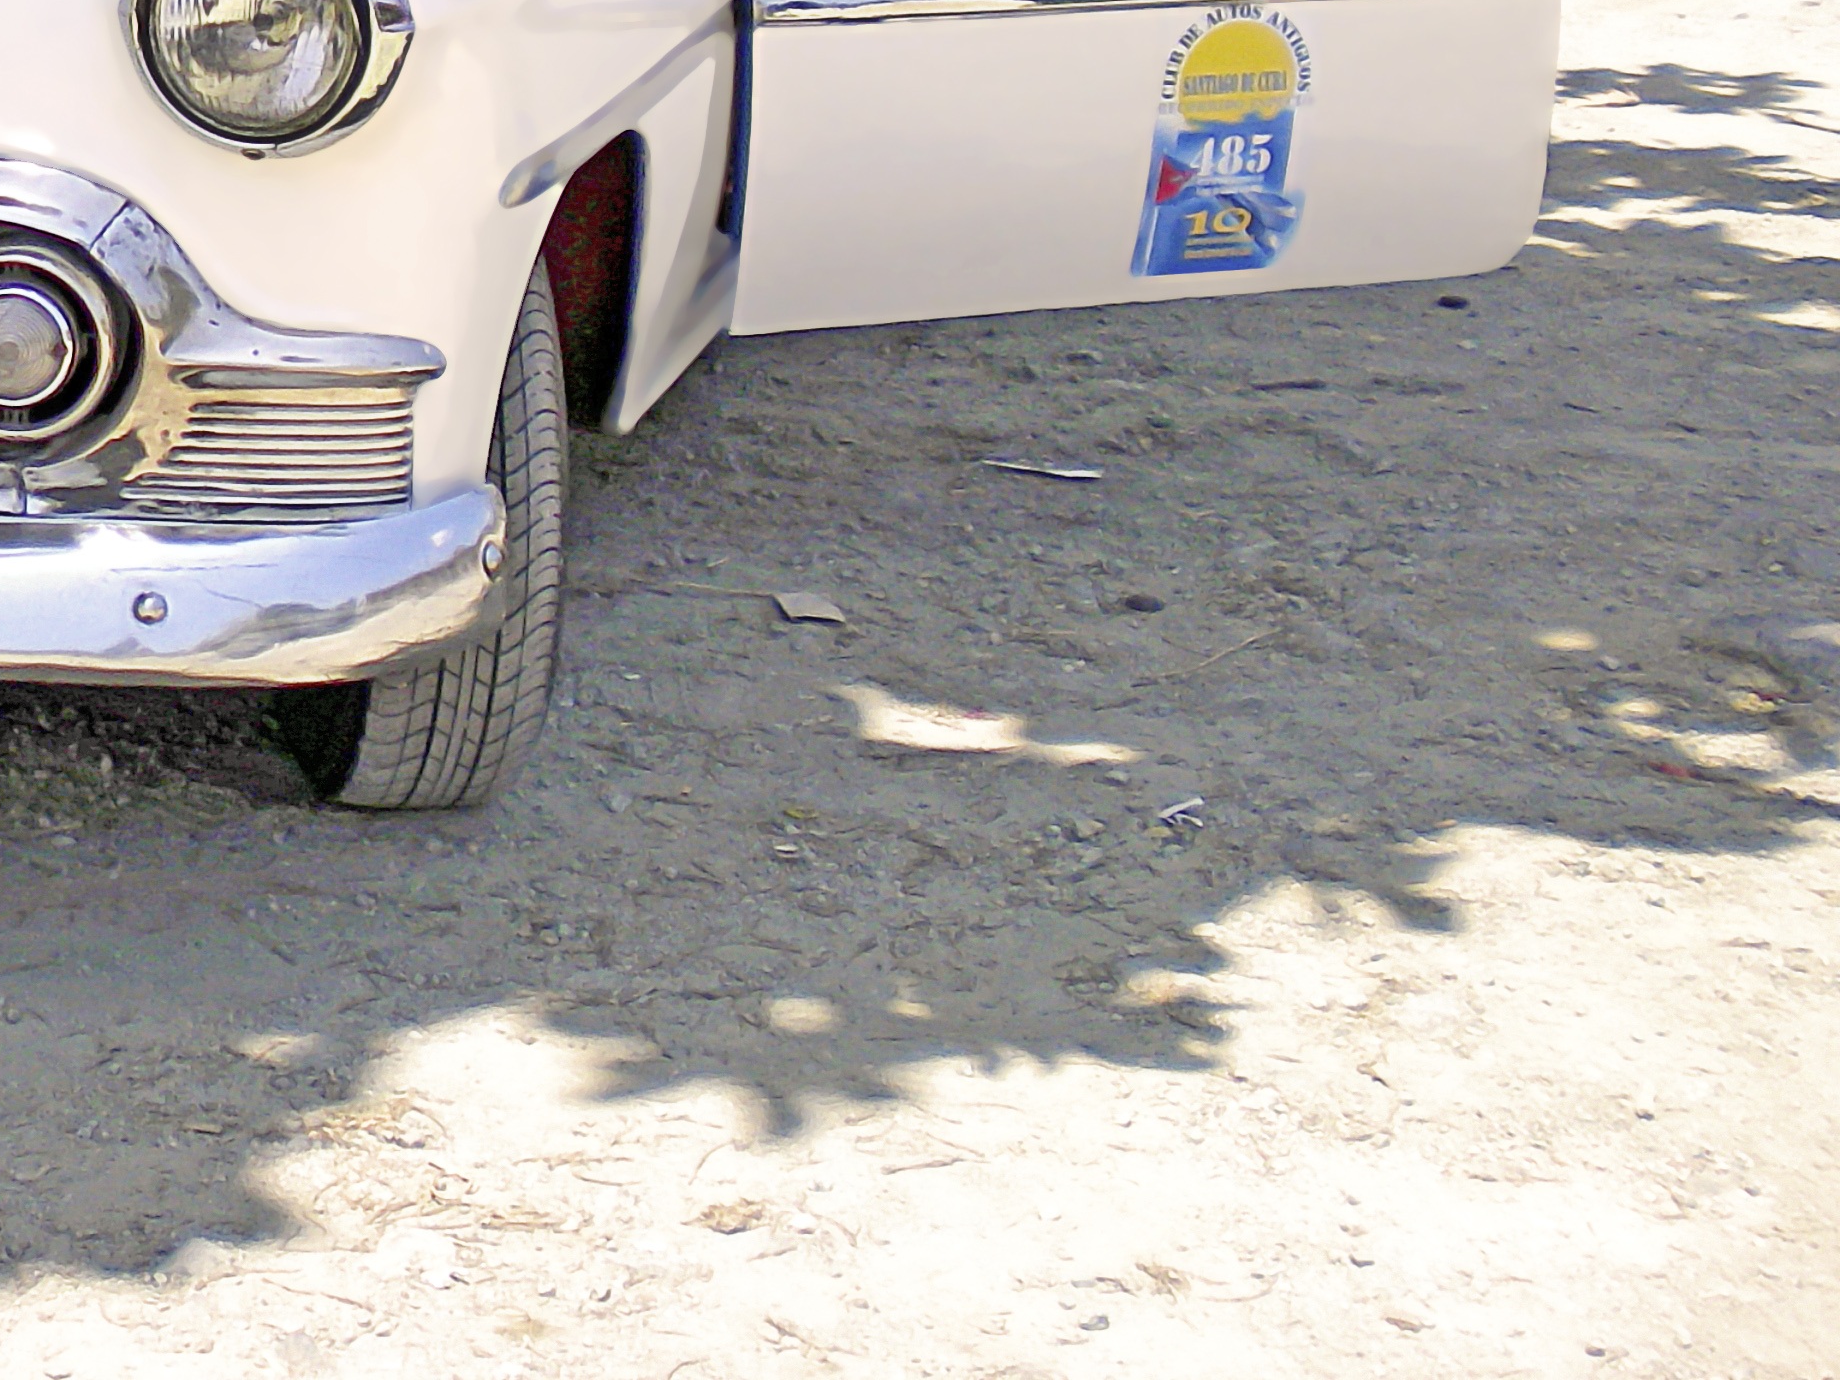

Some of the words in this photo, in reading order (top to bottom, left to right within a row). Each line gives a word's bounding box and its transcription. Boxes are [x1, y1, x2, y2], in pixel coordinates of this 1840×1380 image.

[1161, 50, 1185, 99] CLUB
[1178, 23, 1203, 50] DE
[1206, 3, 1263, 27] AUTOS
[1266, 11, 1311, 93] ANTIGUOS
[1189, 134, 1273, 177] 485
[1185, 207, 1252, 235] 10
